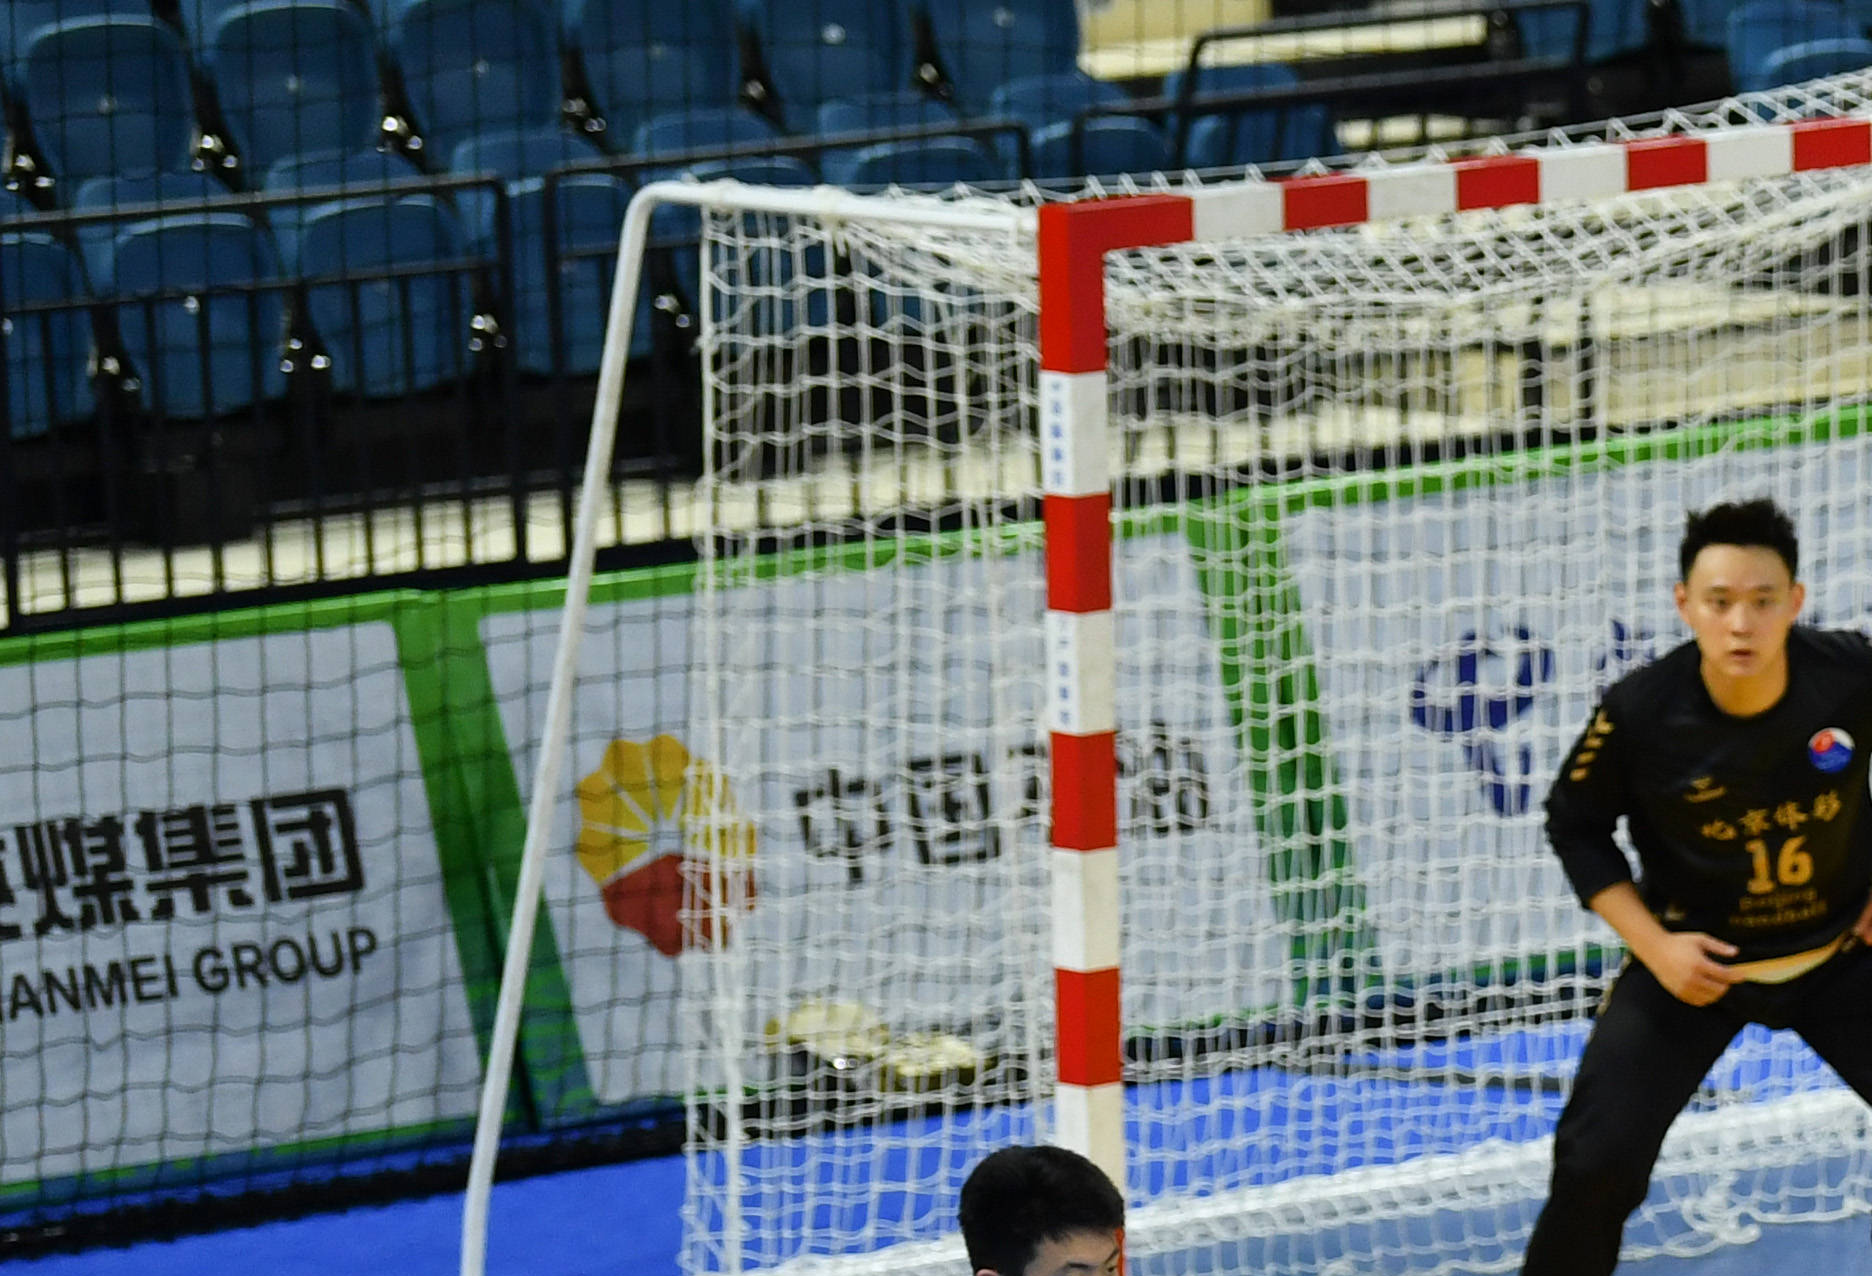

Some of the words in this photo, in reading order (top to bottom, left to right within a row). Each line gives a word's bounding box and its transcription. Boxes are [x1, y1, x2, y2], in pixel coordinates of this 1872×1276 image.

[0, 788, 364, 940] 煤集团
[1745, 834, 1814, 894] 16
[0, 955, 179, 1022] ANMEI
[192, 927, 378, 995] GROUP
